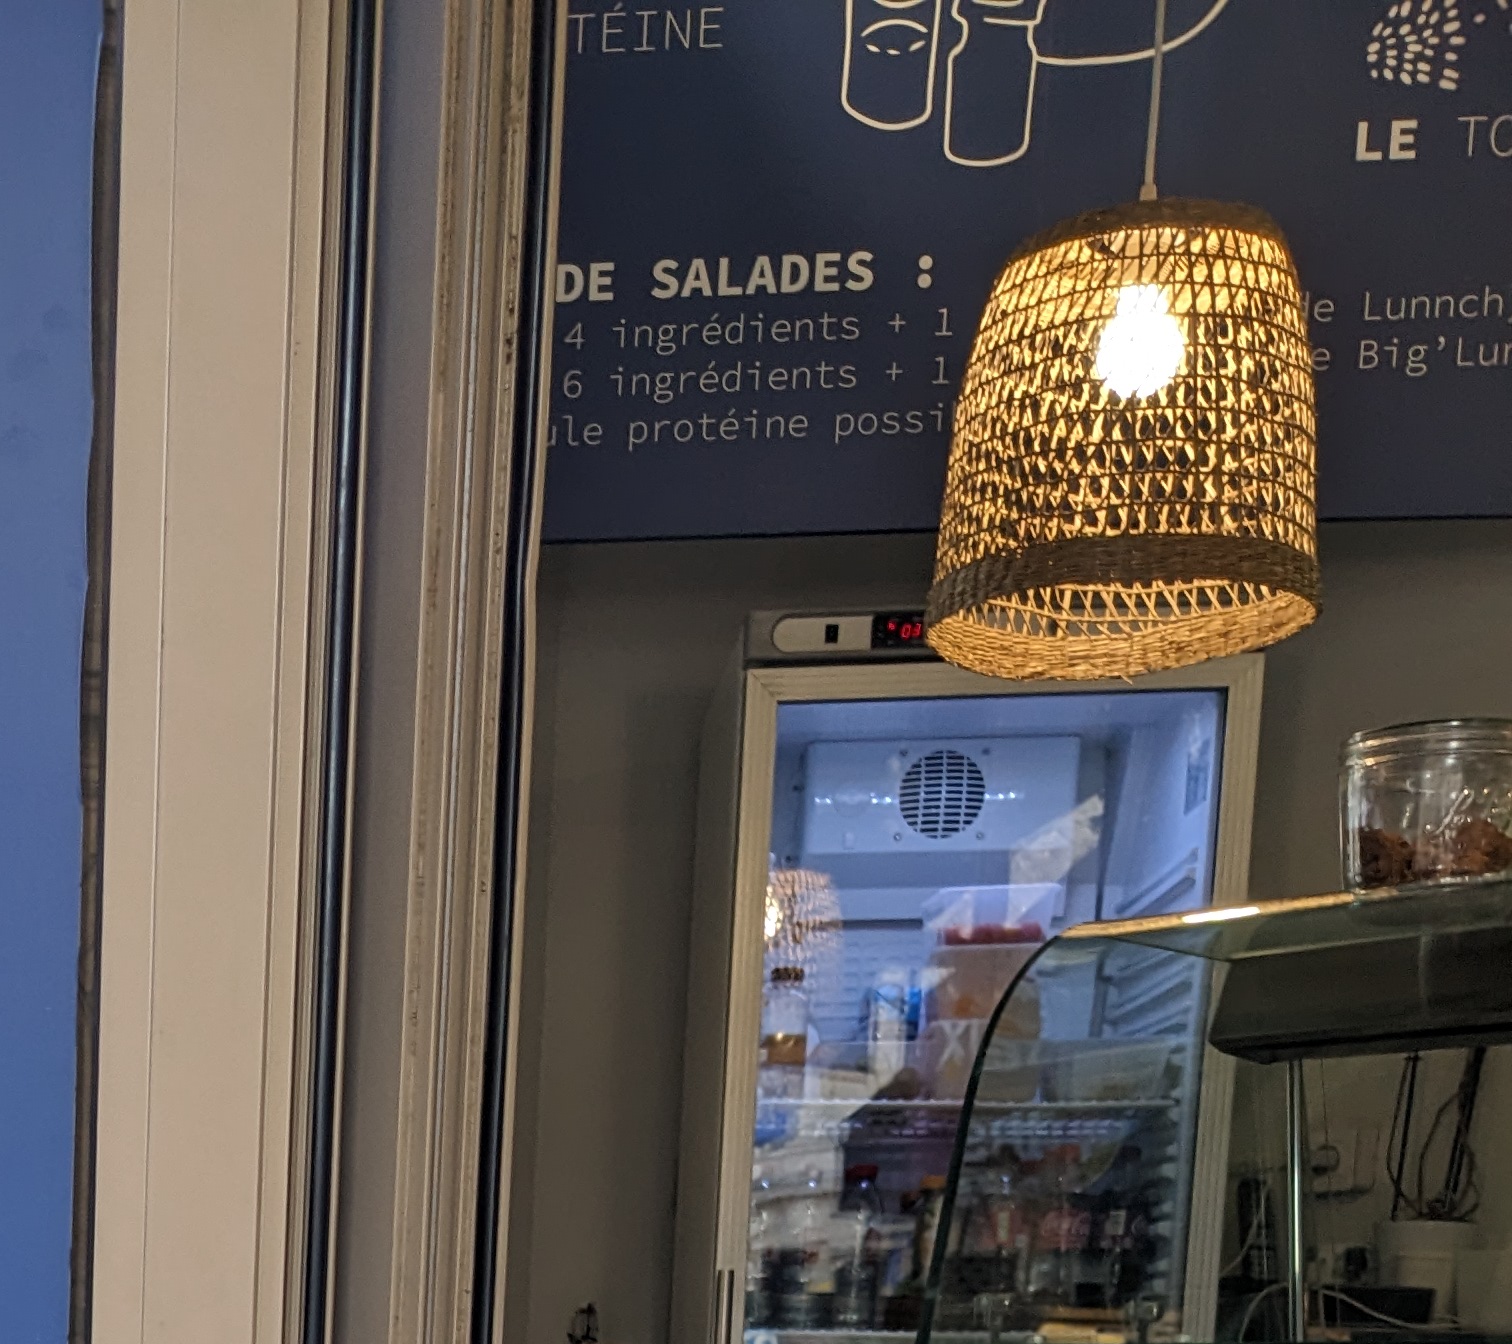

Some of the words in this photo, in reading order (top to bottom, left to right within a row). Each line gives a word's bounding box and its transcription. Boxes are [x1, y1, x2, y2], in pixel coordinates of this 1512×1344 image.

[567, 1, 725, 55] TÉINE
[1355, 119, 1419, 162] LE
[555, 262, 615, 303] DE
[650, 250, 874, 299] SALADES
[1363, 285, 1512, 323] Lunnch
[563, 322, 585, 350] 4
[612, 311, 860, 356] ingrédients
[563, 369, 583, 399] 6
[609, 360, 857, 404] ingrédients
[628, 407, 809, 452] protéine
[833, 401, 957, 445] possi
